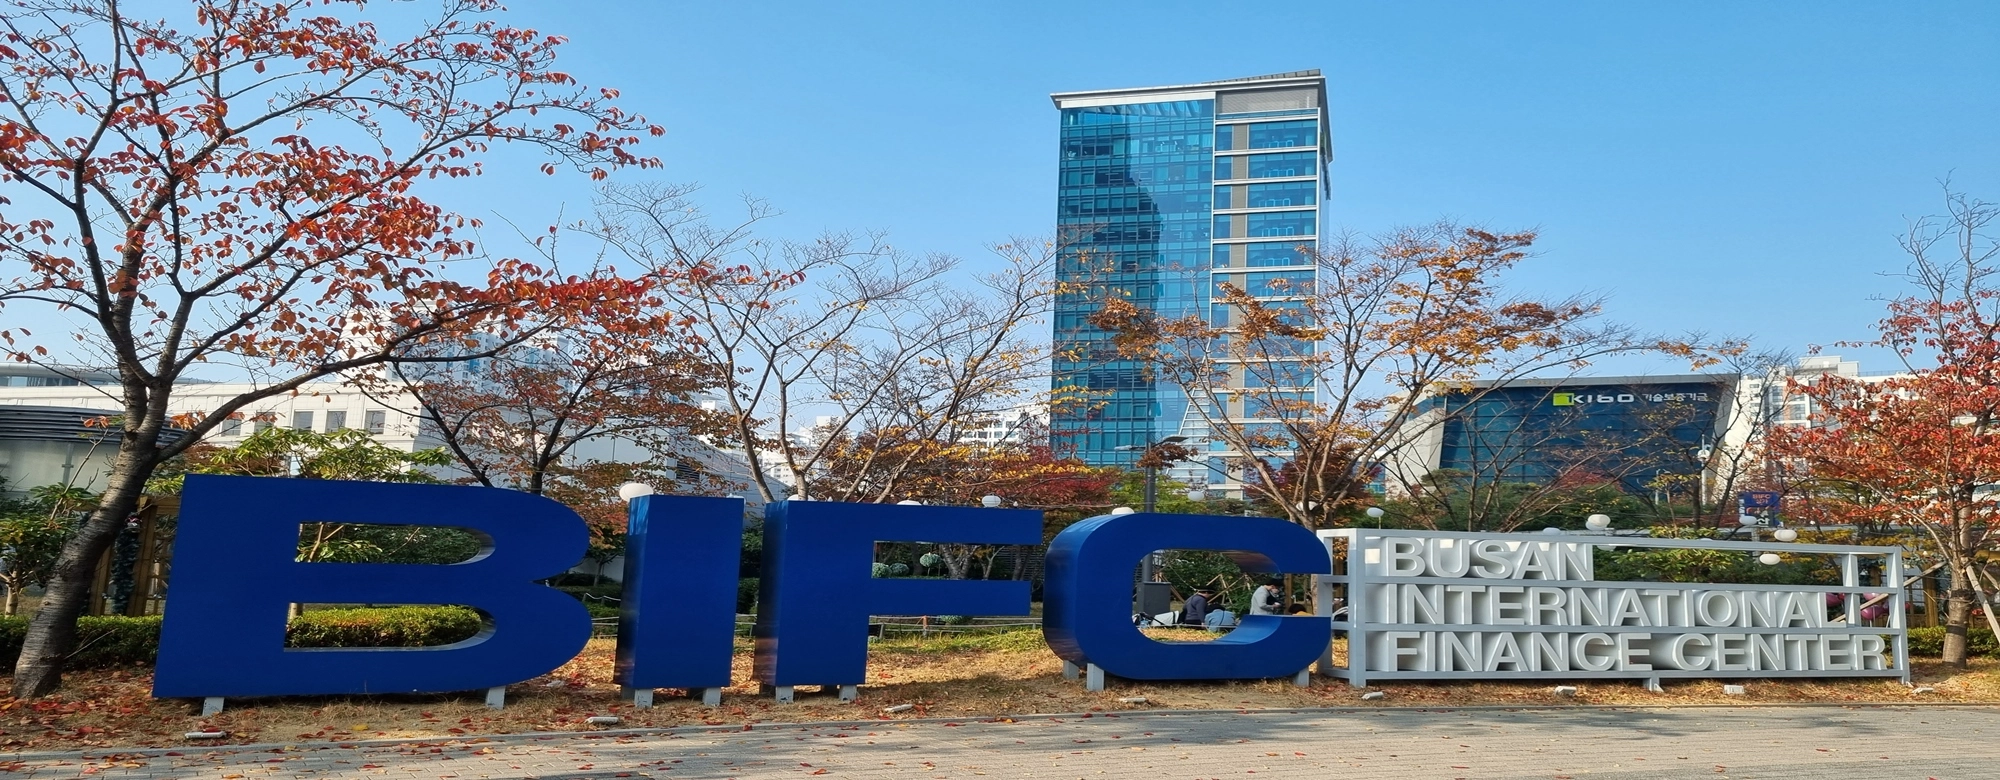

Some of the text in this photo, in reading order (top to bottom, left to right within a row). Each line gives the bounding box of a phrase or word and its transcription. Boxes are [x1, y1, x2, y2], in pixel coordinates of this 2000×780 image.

[1642, 393, 1708, 403] 기술보증기금
[1387, 537, 1595, 581] BUSAN
[153, 474, 1331, 698] BIFC
[1387, 583, 1847, 629] INTERNATIONAL
[1387, 631, 1887, 672] FINANCE CENTER
